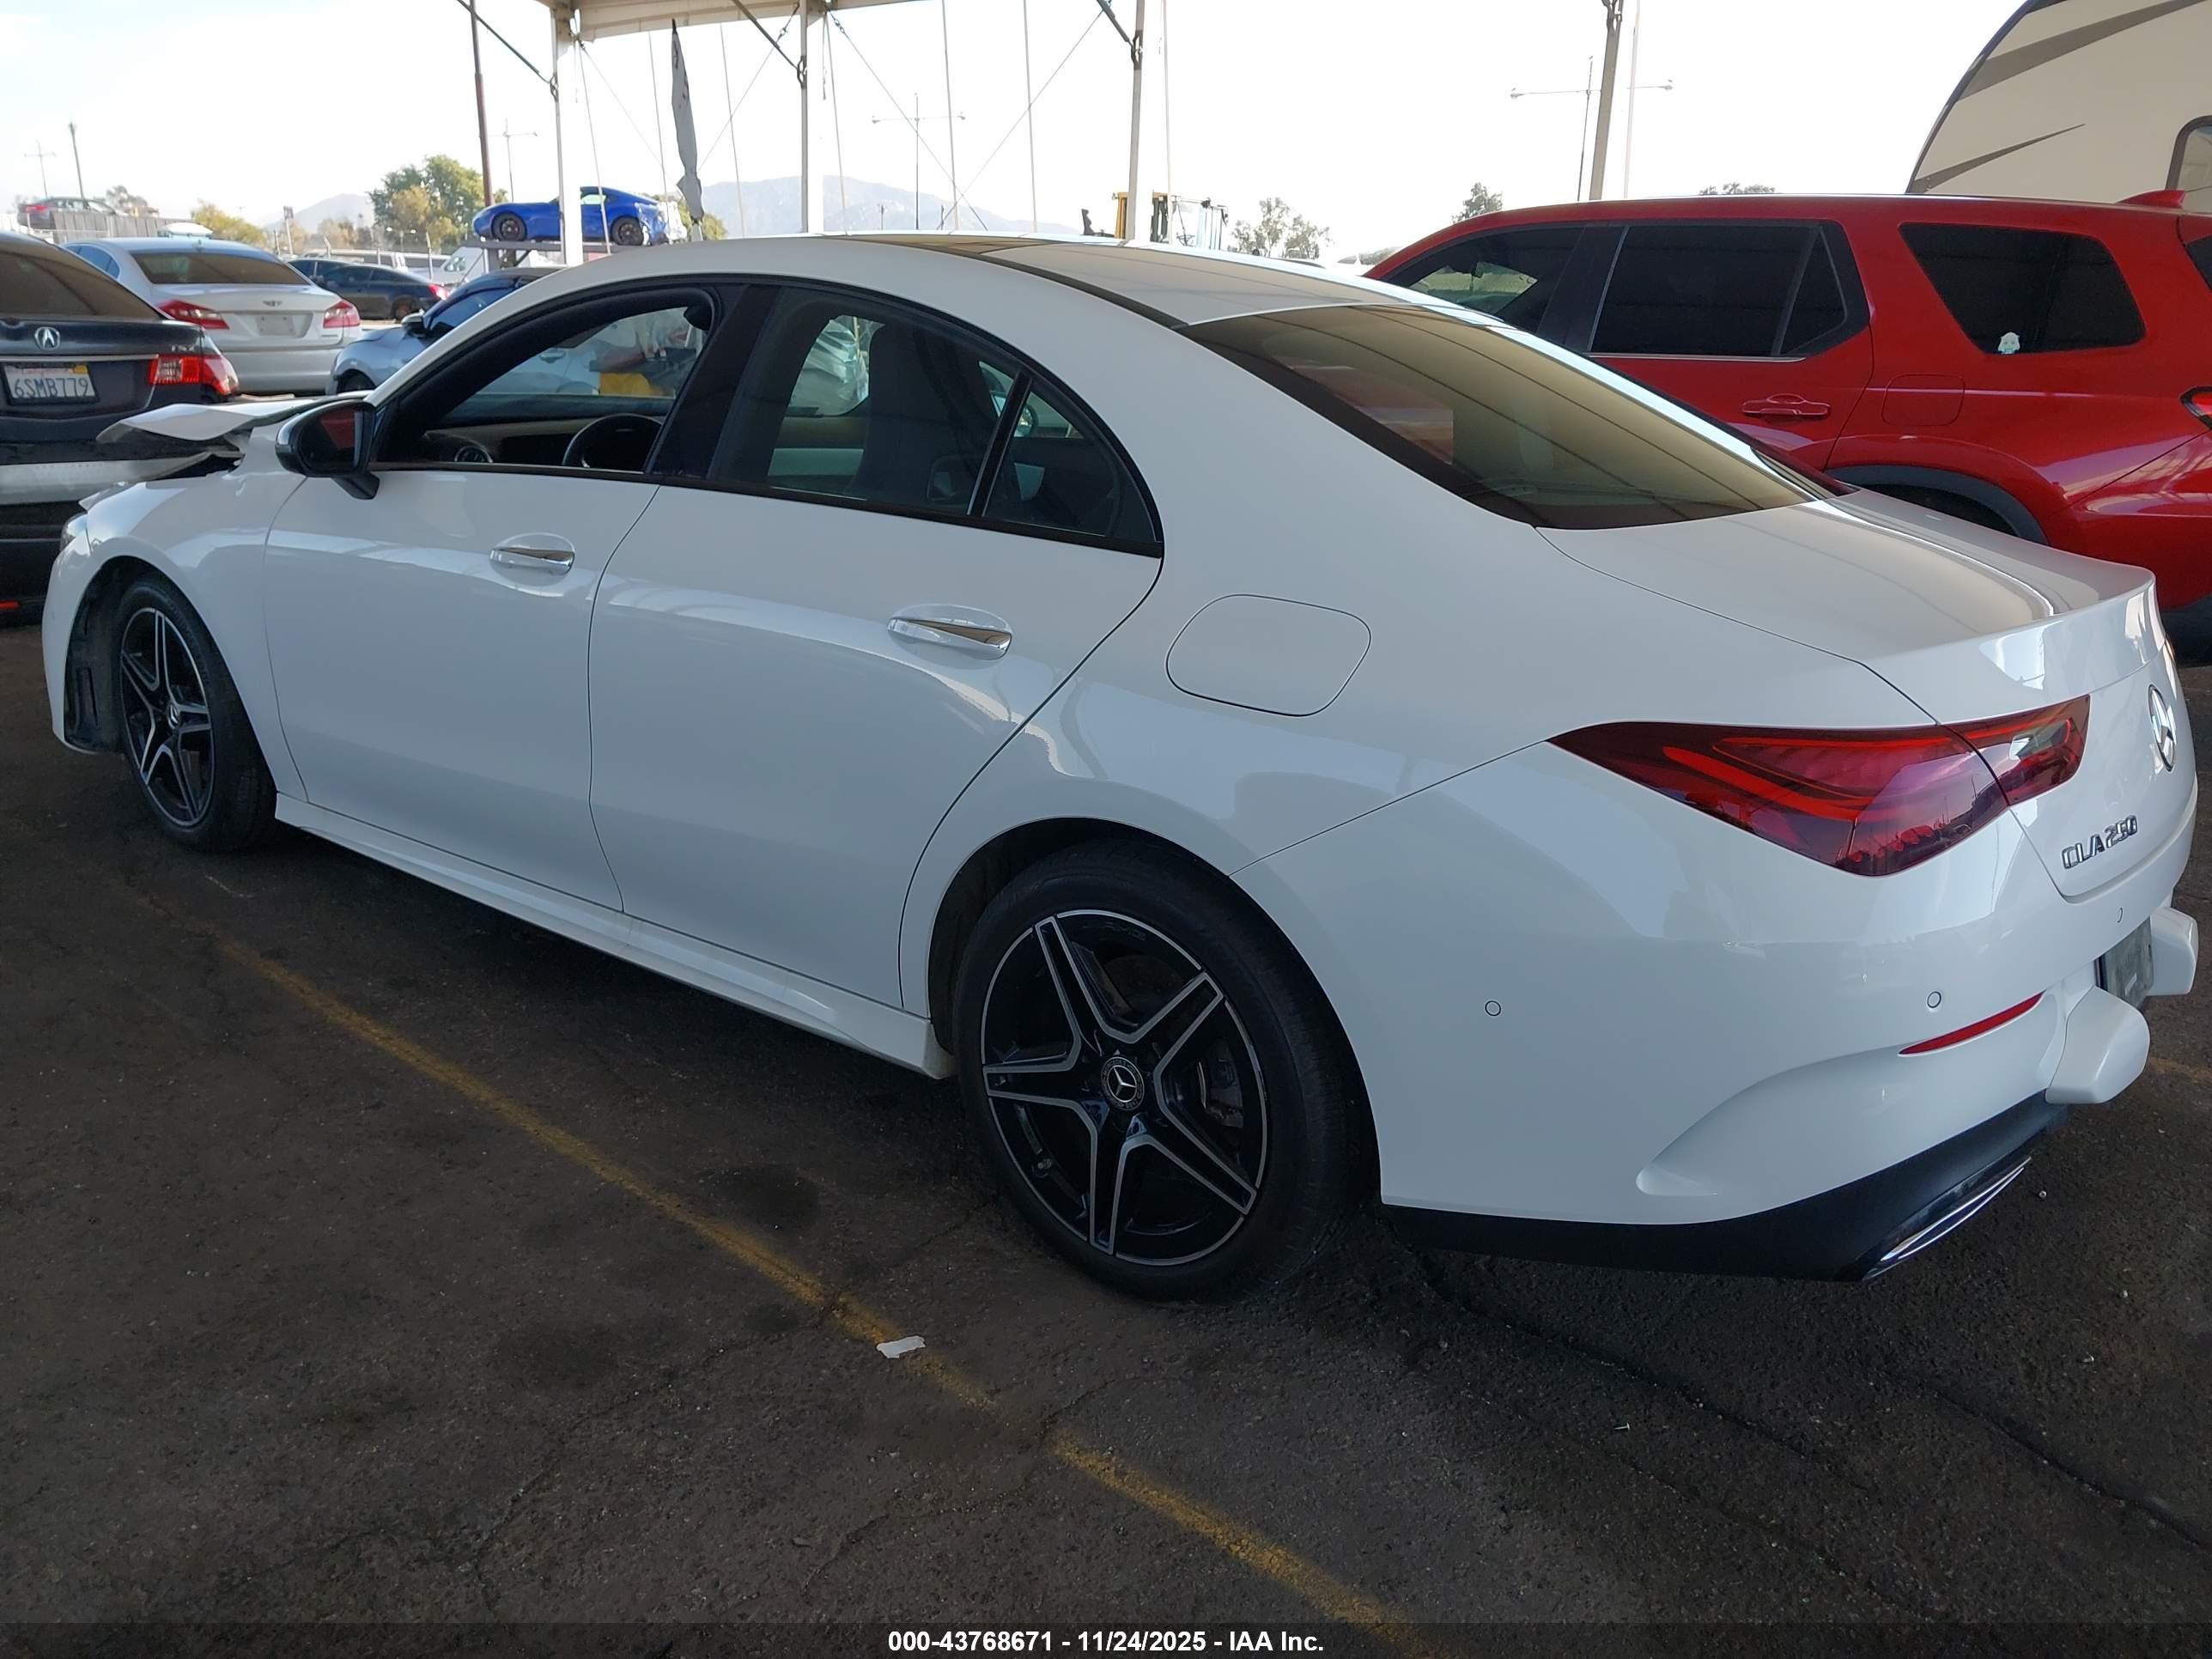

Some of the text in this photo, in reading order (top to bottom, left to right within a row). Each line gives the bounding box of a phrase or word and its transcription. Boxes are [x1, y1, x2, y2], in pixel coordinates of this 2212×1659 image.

[14, 377, 88, 398] 6SMB779
[2062, 814, 2138, 869] CLA 250
